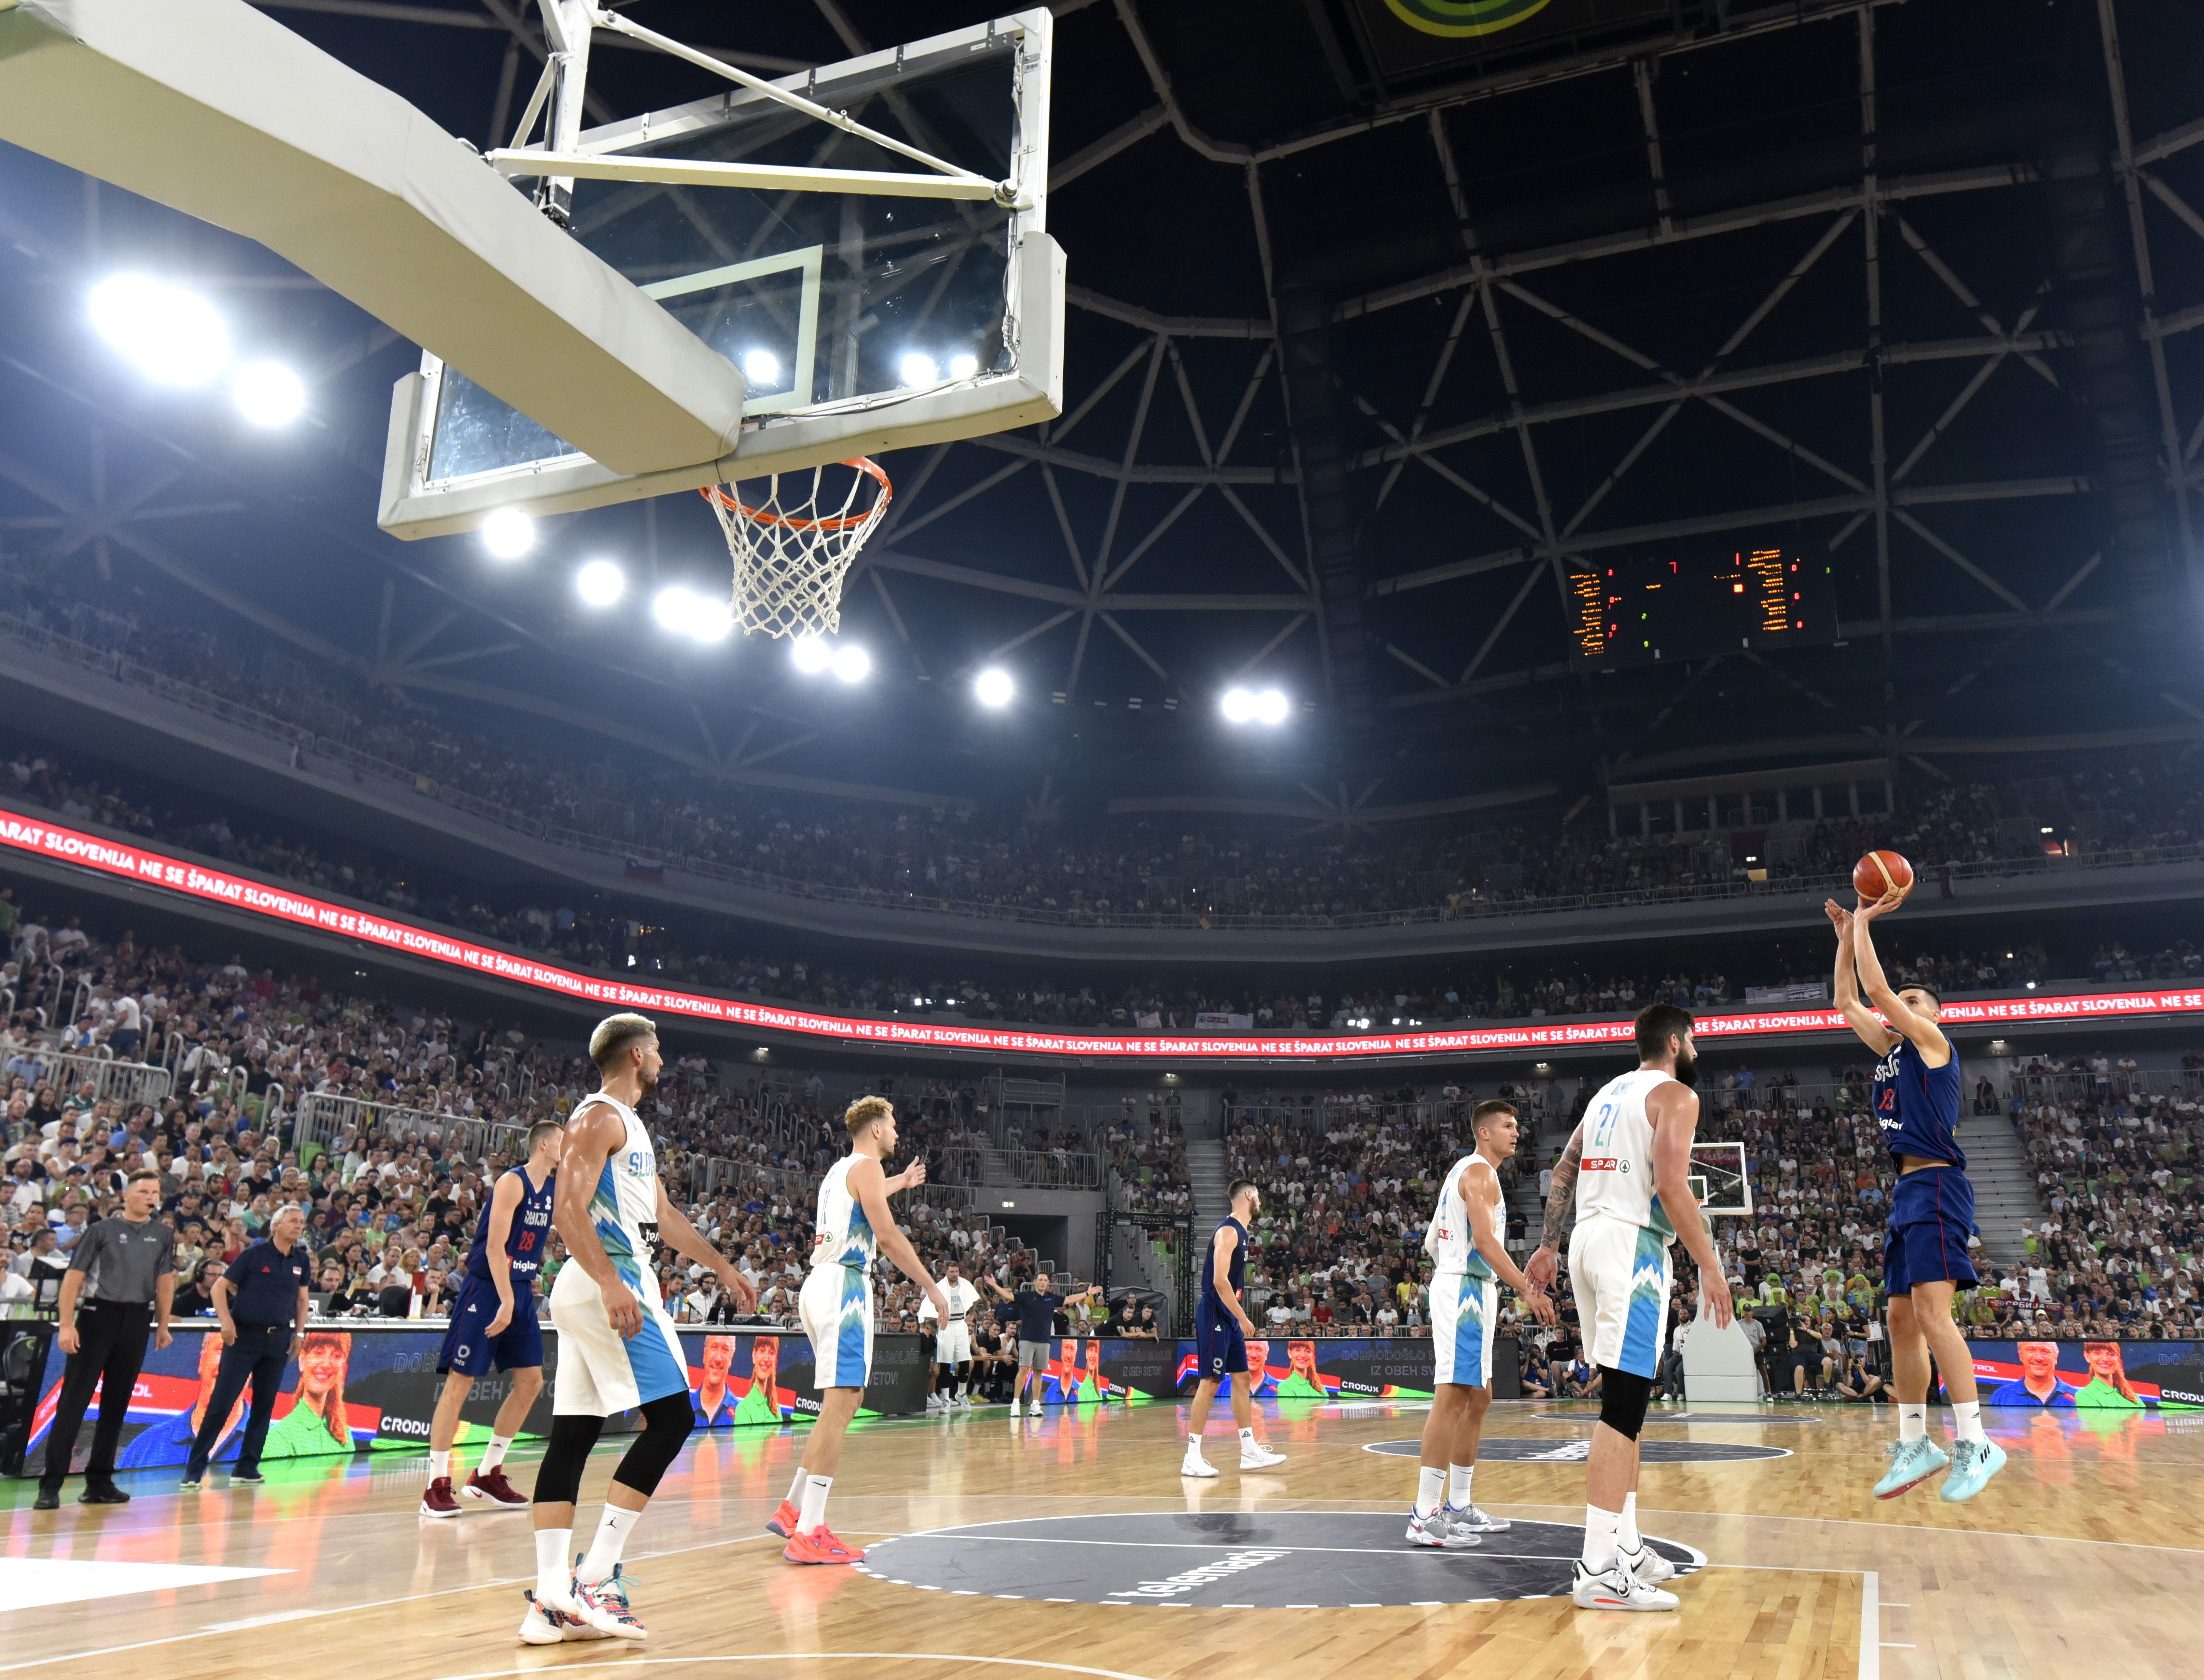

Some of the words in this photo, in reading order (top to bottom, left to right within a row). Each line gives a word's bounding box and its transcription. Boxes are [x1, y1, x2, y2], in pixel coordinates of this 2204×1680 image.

[0, 820, 44, 845] ARAT
[44, 832, 135, 871] SLOVENIJA
[139, 859, 163, 878] NE
[165, 866, 185, 885] SE
[187, 868, 243, 900] ŠPARAT
[244, 888, 315, 920] SLOVENIJA
[318, 909, 338, 927] NE
[339, 914, 356, 931] SE
[357, 916, 402, 943] ŠPARAT
[403, 932, 461, 959] SLOVENIJA
[464, 950, 479, 965] NE
[481, 954, 494, 969] SE
[495, 955, 533, 978] ŠPARAT
[533, 968, 582, 992] SLOVENIJA
[584, 983, 601, 996] NE
[602, 986, 617, 999] SE
[619, 986, 662, 1006] ŠPARAT
[664, 996, 722, 1015] SLOVENIJA
[726, 1006, 741, 1019] NE
[743, 1009, 756, 1021] SE
[758, 1009, 797, 1027] ŠPARAT
[798, 1017, 853, 1033] SLOVENIJA
[856, 1024, 872, 1035] NE
[875, 1026, 888, 1037] SE
[891, 1025, 932, 1040] ŠPARAT
[934, 1030, 991, 1044] SLOVENIJA
[994, 1035, 1009, 1046] NE
[1011, 1037, 1024, 1047] SE
[1026, 1035, 1065, 1050] ŠPARAT
[1066, 1040, 1123, 1051] SLOVENIJA
[1126, 1042, 1142, 1051] NE
[1144, 1042, 1157, 1052] SE
[1159, 1040, 1199, 1052] ŠPARAT
[1201, 1042, 1258, 1052] SLOVENIJA
[1261, 1042, 1276, 1052] NE
[1279, 1042, 1292, 1053] SE
[1294, 1040, 1334, 1053] ŠPARAT
[1335, 1040, 1392, 1051] SLOVENIJA
[1395, 1039, 1411, 1049] NE
[1412, 1038, 1426, 1048] SE
[1428, 1035, 1468, 1047] ŠPARAT
[1470, 1032, 1529, 1044] SLOVENIJA
[1532, 1031, 1548, 1042] NE
[1550, 1030, 1563, 1041] SE
[1566, 1027, 1608, 1040] ŠPARAT
[1695, 1022, 1709, 1032] SE
[1711, 1019, 1756, 1032] ŠPARAT
[1758, 1015, 1825, 1028] SLOVENIJA
[1827, 1014, 1845, 1025] NE
[1941, 1006, 1985, 1018] VENIJA
[1988, 1005, 2008, 1017] NE
[2009, 1004, 2027, 1015] SE
[2029, 1001, 2079, 1014] ŠPARAT
[2081, 997, 2157, 1011] SLOVENIJA
[2161, 996, 2182, 1007] NE
[2184, 994, 2202, 1006] SE
[1878, 1088, 1896, 1110] 13
[1595, 1103, 1622, 1147] 27
[1879, 1117, 1904, 1131] iglav
[1590, 1160, 1616, 1169] SPAR
[518, 1231, 536, 1252] 28
[2005, 1300, 2045, 1310] СРБИЈА
[1342, 1347, 1425, 1361] DOBRODOŠLO
[454, 1357, 466, 1367] mts
[1973, 1363, 1998, 1373] TROL
[1371, 1365, 1381, 1376] IZ
[1385, 1365, 1418, 1377] OBEH
[868, 1371, 899, 1386] VETOV!
[469, 1380, 504, 1401] BEH
[1109, 1382, 1126, 1395] CRODUX
[1341, 1380, 1379, 1393] CRODUX
[2161, 1389, 2204, 1403] CRODU
[796, 1396, 823, 1411] CRODU
[381, 1416, 431, 1437] CRODU
[1107, 1550, 1292, 1598] telemach
